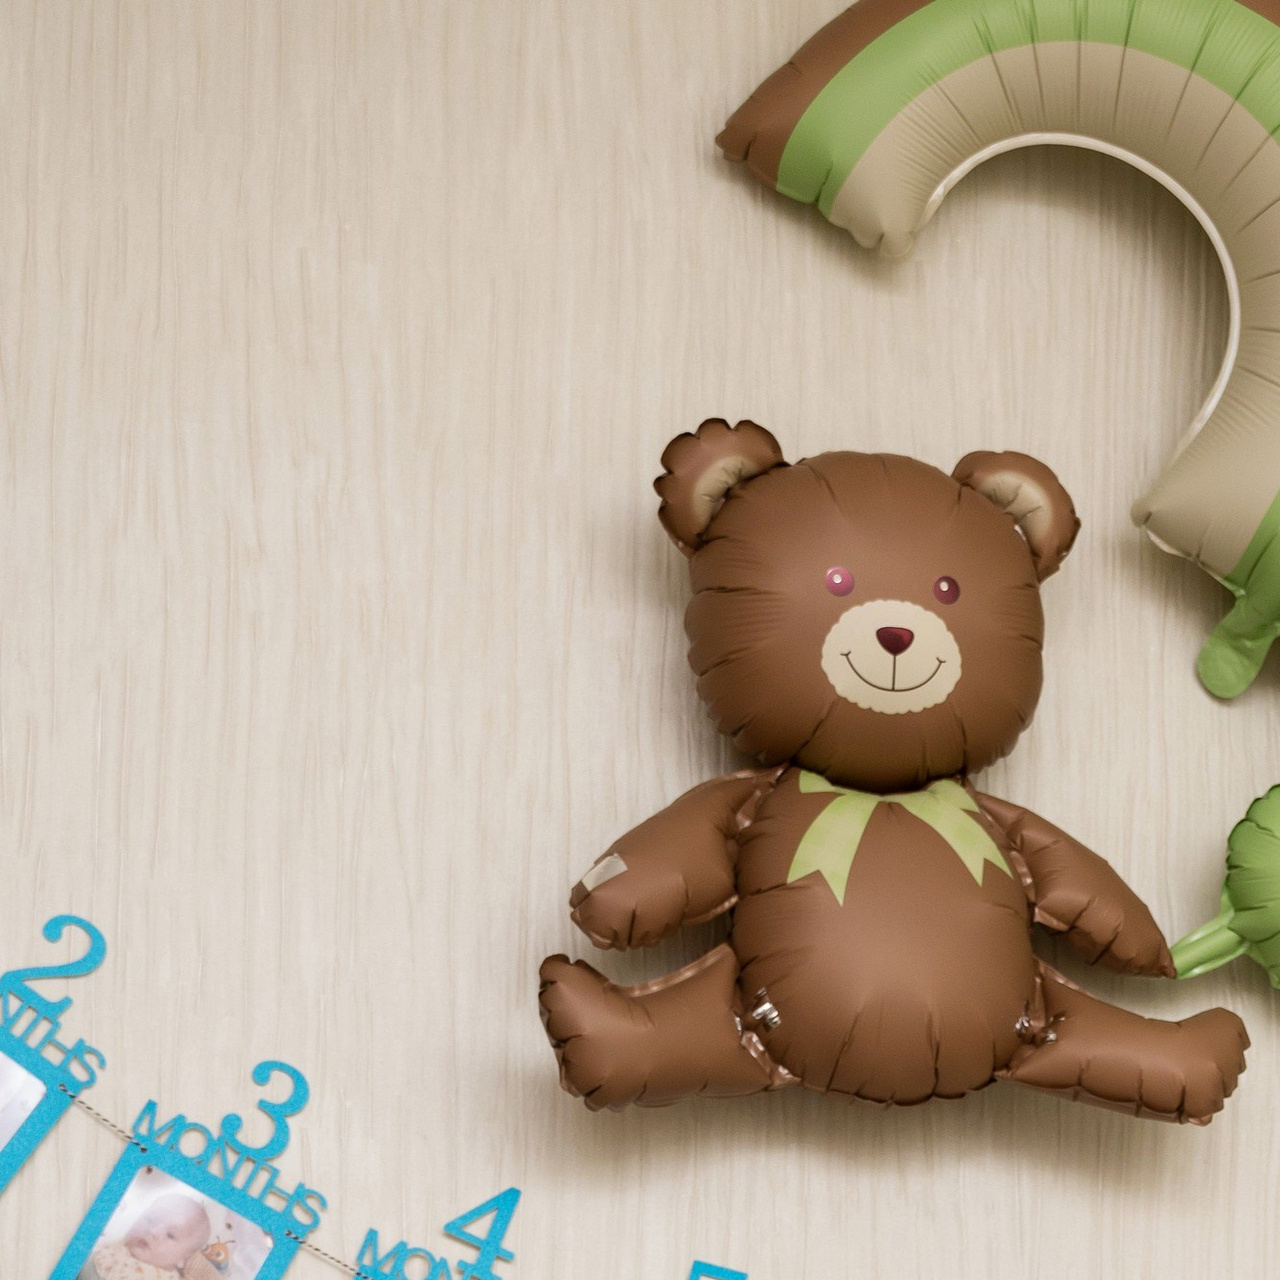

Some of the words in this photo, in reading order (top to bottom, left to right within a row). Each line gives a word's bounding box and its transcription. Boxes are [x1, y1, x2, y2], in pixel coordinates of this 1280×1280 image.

[0, 914, 107, 1018] 2
[0, 988, 107, 1088] NTHS
[221, 1060, 310, 1161] 3
[130, 1100, 328, 1231] MONTHS
[443, 1187, 523, 1279] 4
